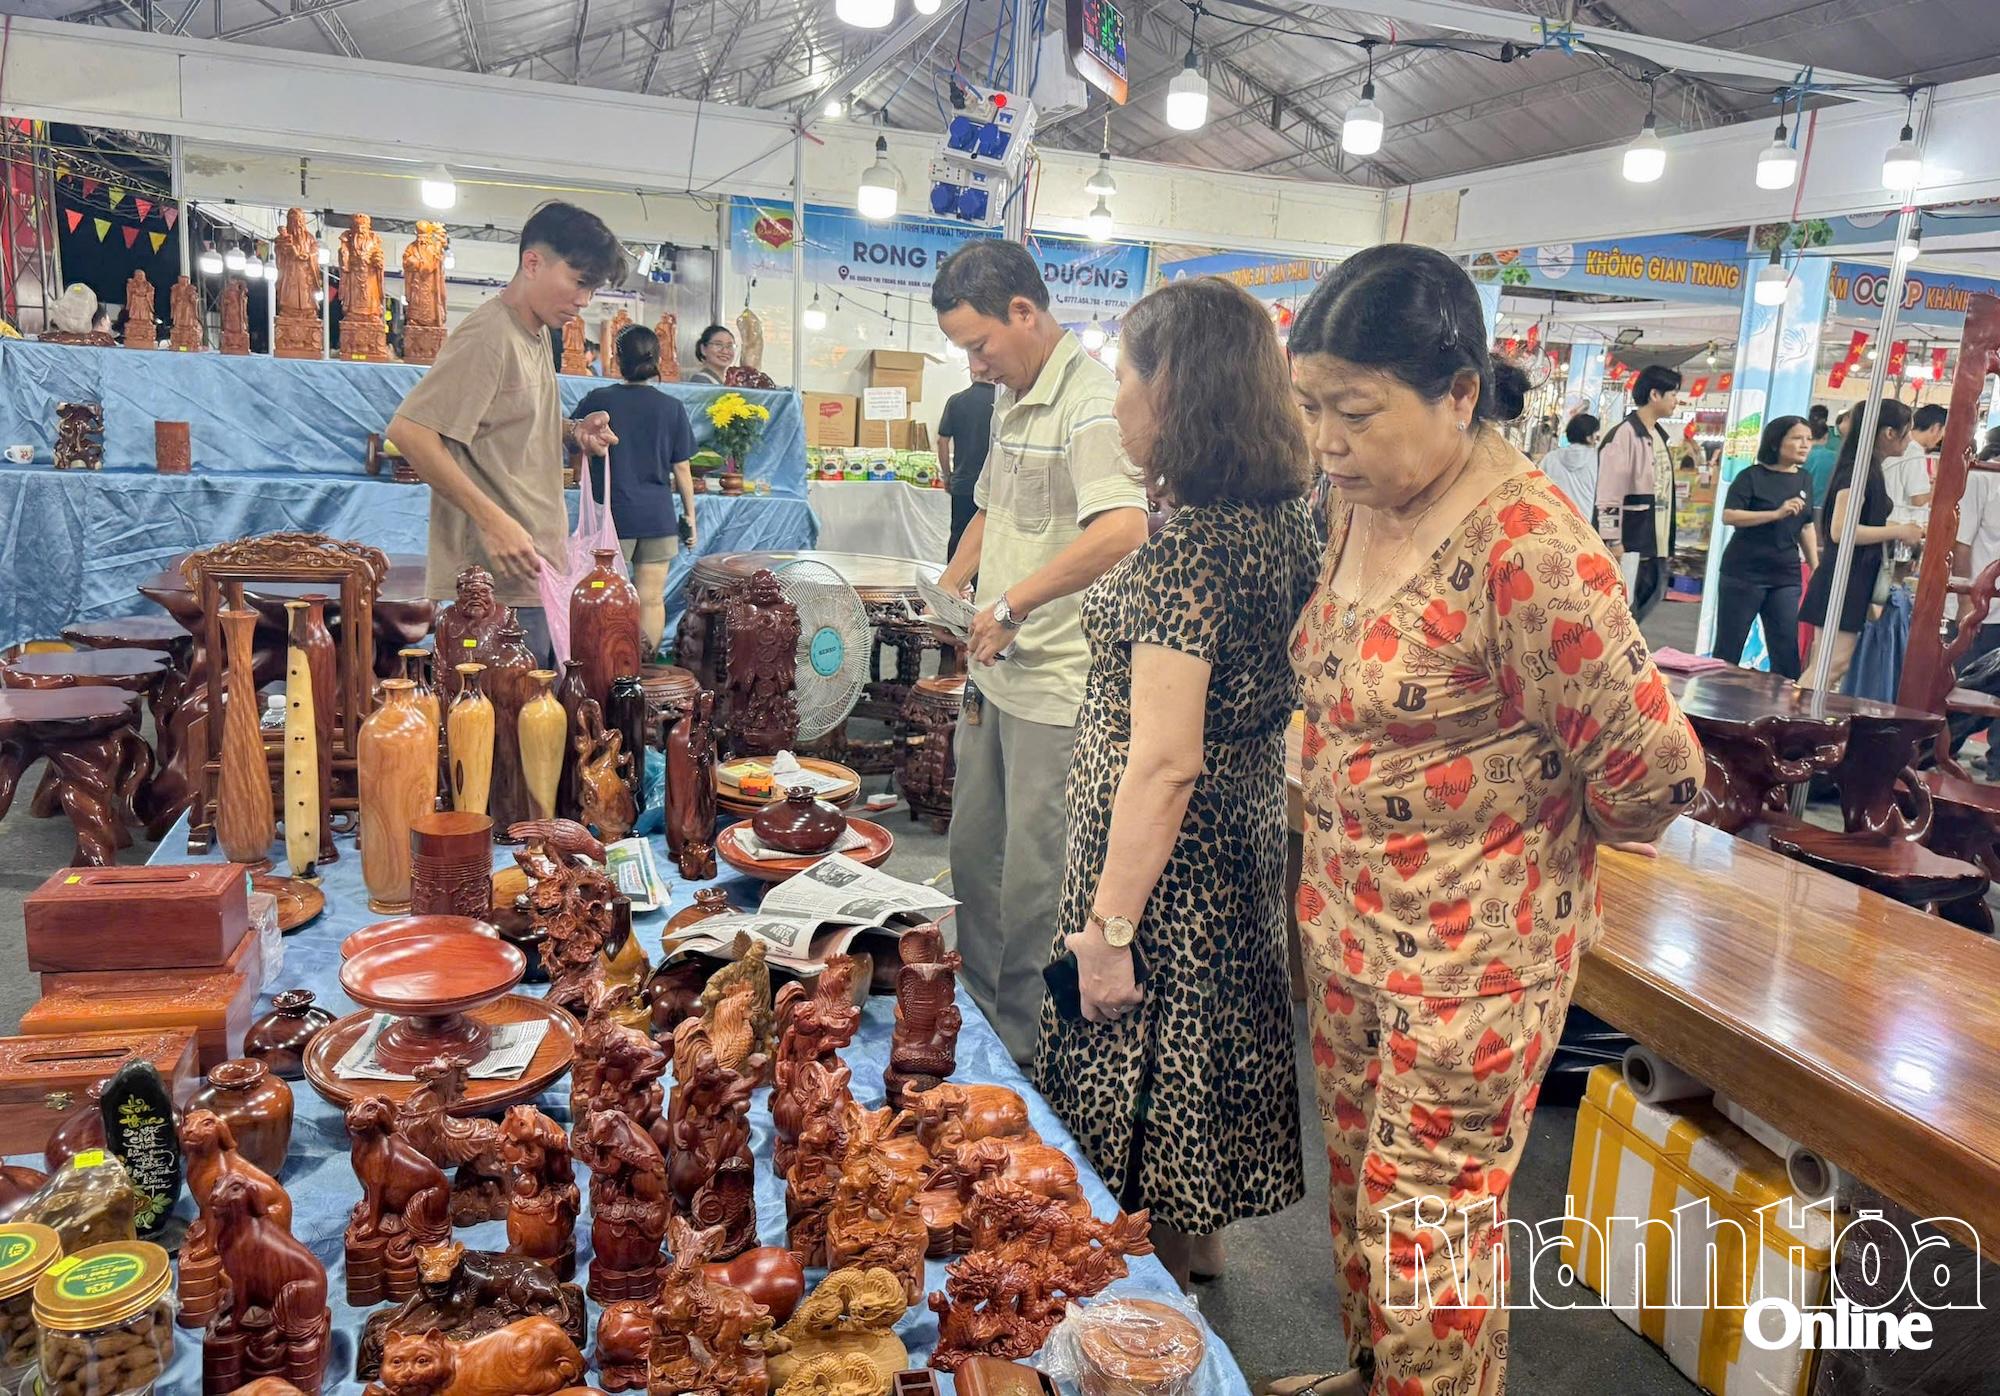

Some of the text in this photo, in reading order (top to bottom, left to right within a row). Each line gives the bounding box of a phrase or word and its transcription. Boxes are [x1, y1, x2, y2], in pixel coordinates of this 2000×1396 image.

[853, 241, 927, 269] RONG
[1585, 246, 1741, 289] KHÔNG GIAN TRƯNG
[1044, 262, 1128, 289] DƯƠNG
[1853, 273, 1924, 309] OCP
[1393, 681, 1427, 711] B
[1382, 795, 1413, 821] B
